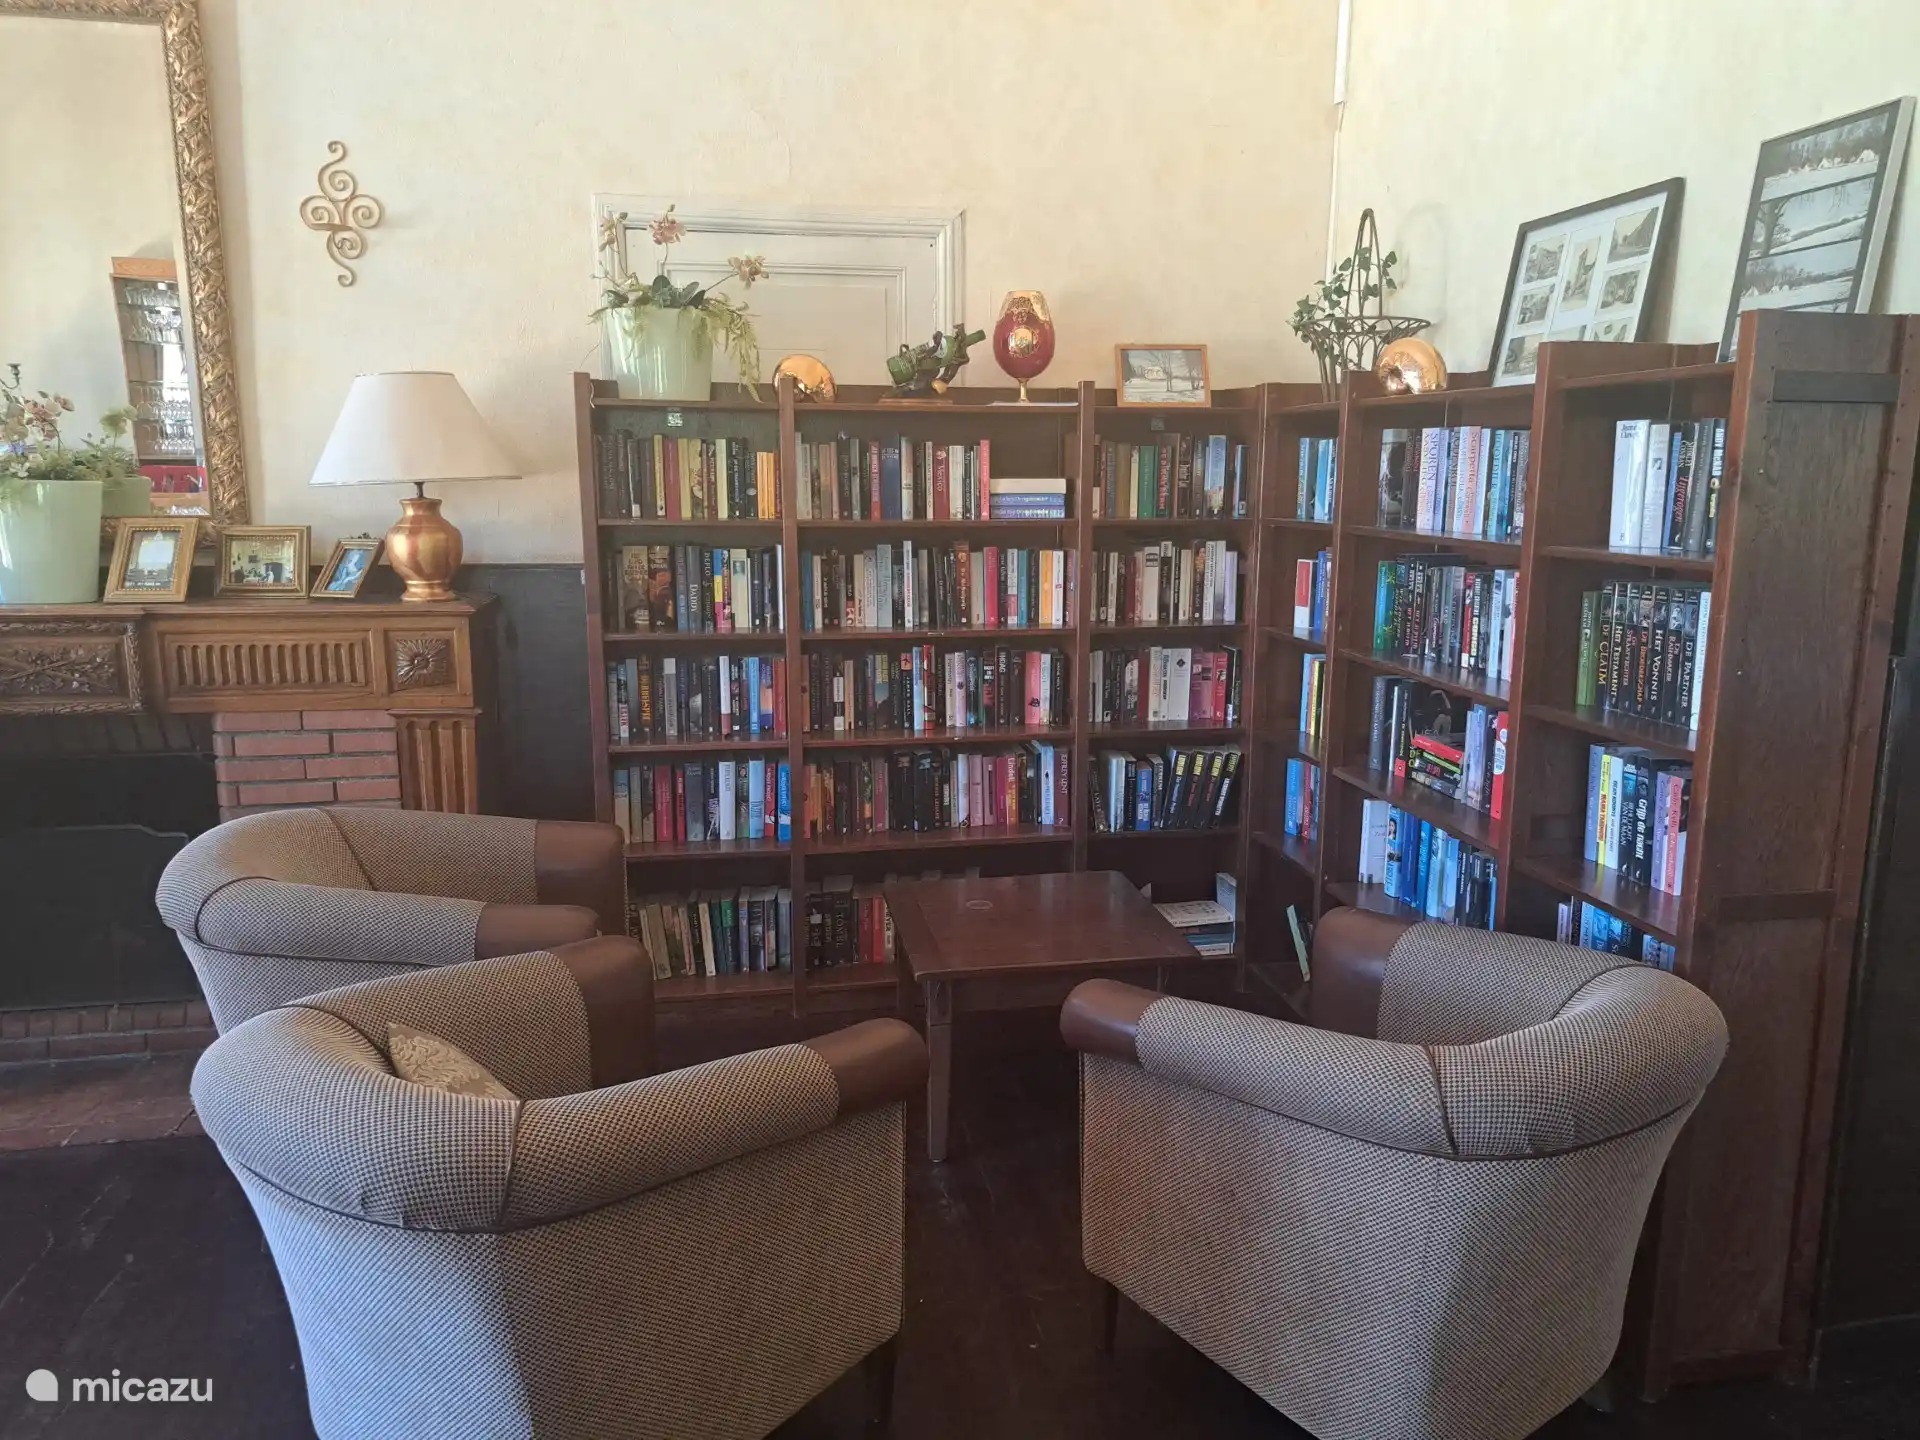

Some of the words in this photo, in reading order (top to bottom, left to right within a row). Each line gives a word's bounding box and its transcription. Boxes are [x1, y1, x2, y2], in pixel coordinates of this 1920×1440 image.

[1714, 427, 1725, 448] ANDY
[935, 464, 945, 492] Mexico
[1614, 624, 1623, 643] HET
[1653, 629, 1663, 652] HET
[1665, 635, 1676, 683] RAINMAKER
[1684, 641, 1694, 657] DE
[1597, 641, 1609, 685] CLAIM
[1610, 645, 1621, 697] TESTAMENT
[1636, 645, 1648, 702] BROEDERSCHAP
[1649, 655, 1660, 701] VONNIS
[1680, 661, 1692, 709] PARTNER
[1060, 753, 1068, 777] JEFFREY
[1060, 778, 1068, 795] LENT
[1635, 798, 1649, 820] Grijp
[1636, 821, 1646, 833] de
[1634, 833, 1646, 860] nacht
